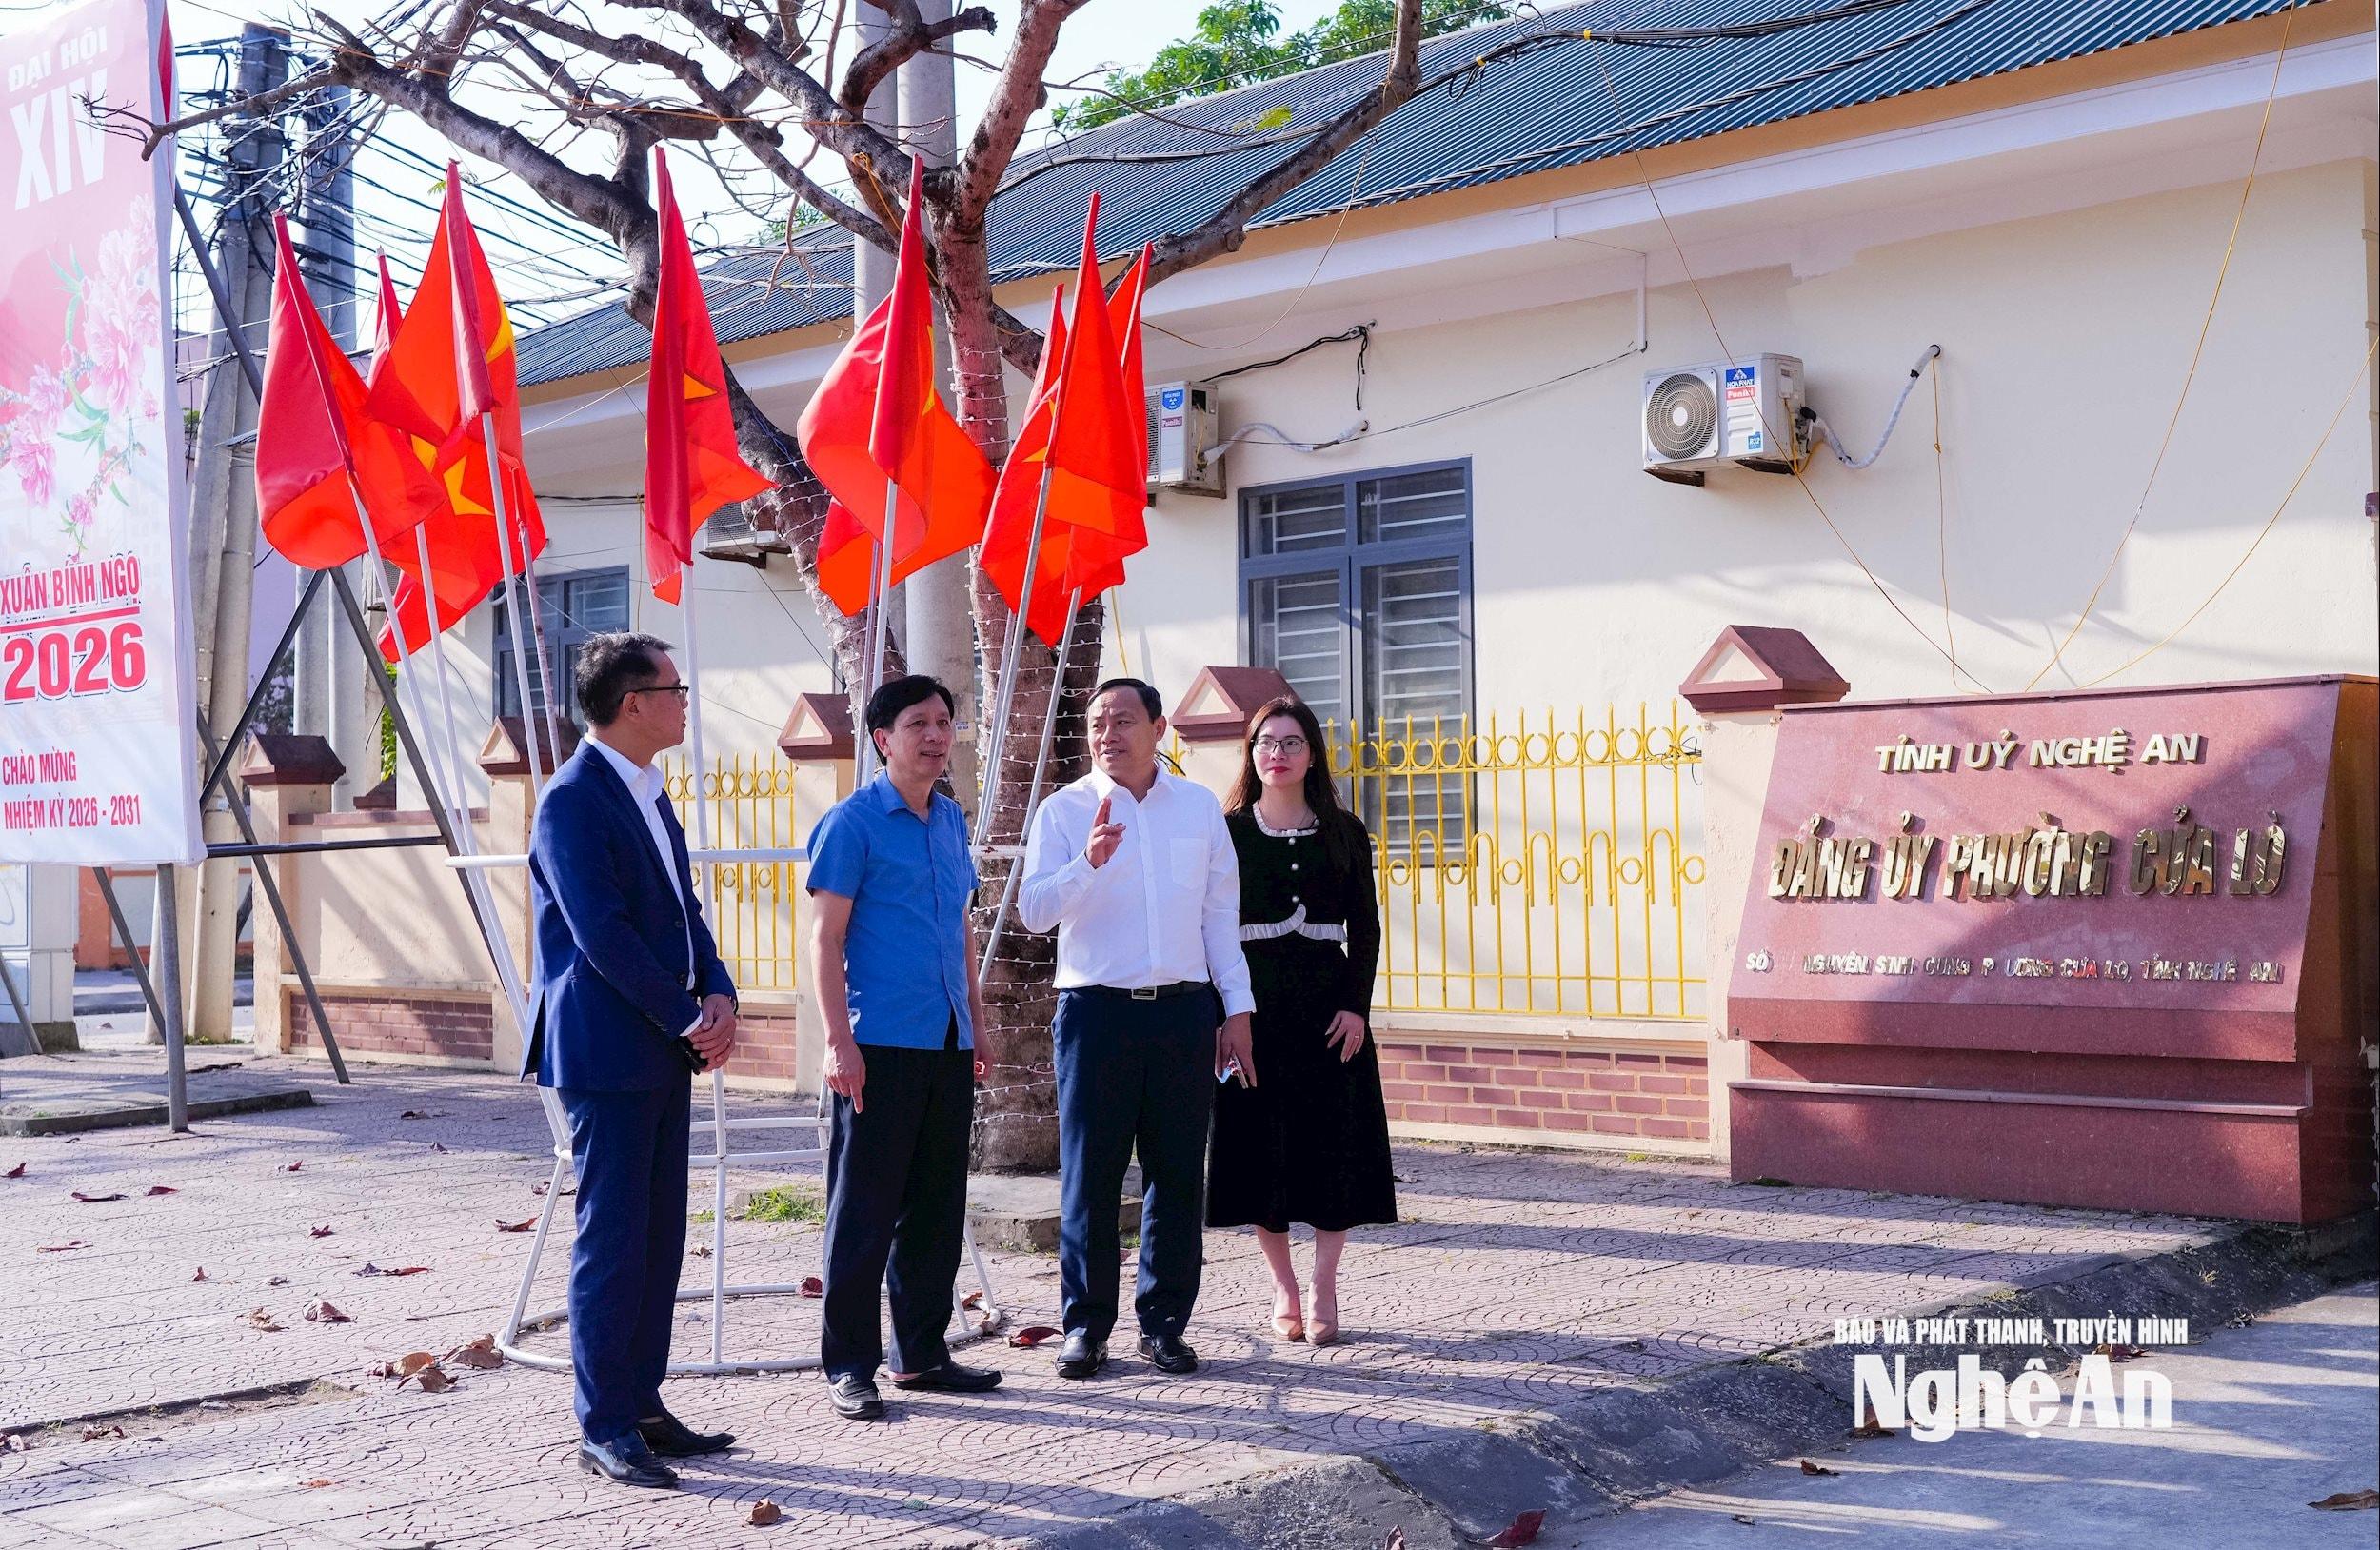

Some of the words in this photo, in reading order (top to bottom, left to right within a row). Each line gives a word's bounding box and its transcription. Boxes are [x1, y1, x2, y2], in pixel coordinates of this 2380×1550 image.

[8, 51, 52, 92] ĐẠI
[60, 26, 108, 70] HỘI
[10, 67, 108, 211] XIV
[0, 564, 48, 615] XUÂN
[52, 560, 96, 607] BÍNH
[100, 555, 140, 604] NGỌ
[4, 622, 146, 701] 2026
[2, 749, 35, 785] CHÀO
[39, 746, 77, 783] MỪNG
[1875, 734, 1952, 772] TỈNH
[1964, 728, 2019, 768] UỶ
[2029, 727, 2129, 773] NGHỆ
[2140, 733, 2201, 764] AN
[4, 794, 46, 836] NHIỆM
[49, 792, 64, 828] KỲ
[69, 796, 98, 827] 2026
[110, 794, 142, 826] 2031
[1768, 812, 1874, 899] ĐẢNG
[1881, 810, 1937, 899] ỦY
[1943, 811, 2111, 897] PHƯỜNG
[2130, 805, 2214, 896] CỬA
[2230, 809, 2286, 896] LÒ
